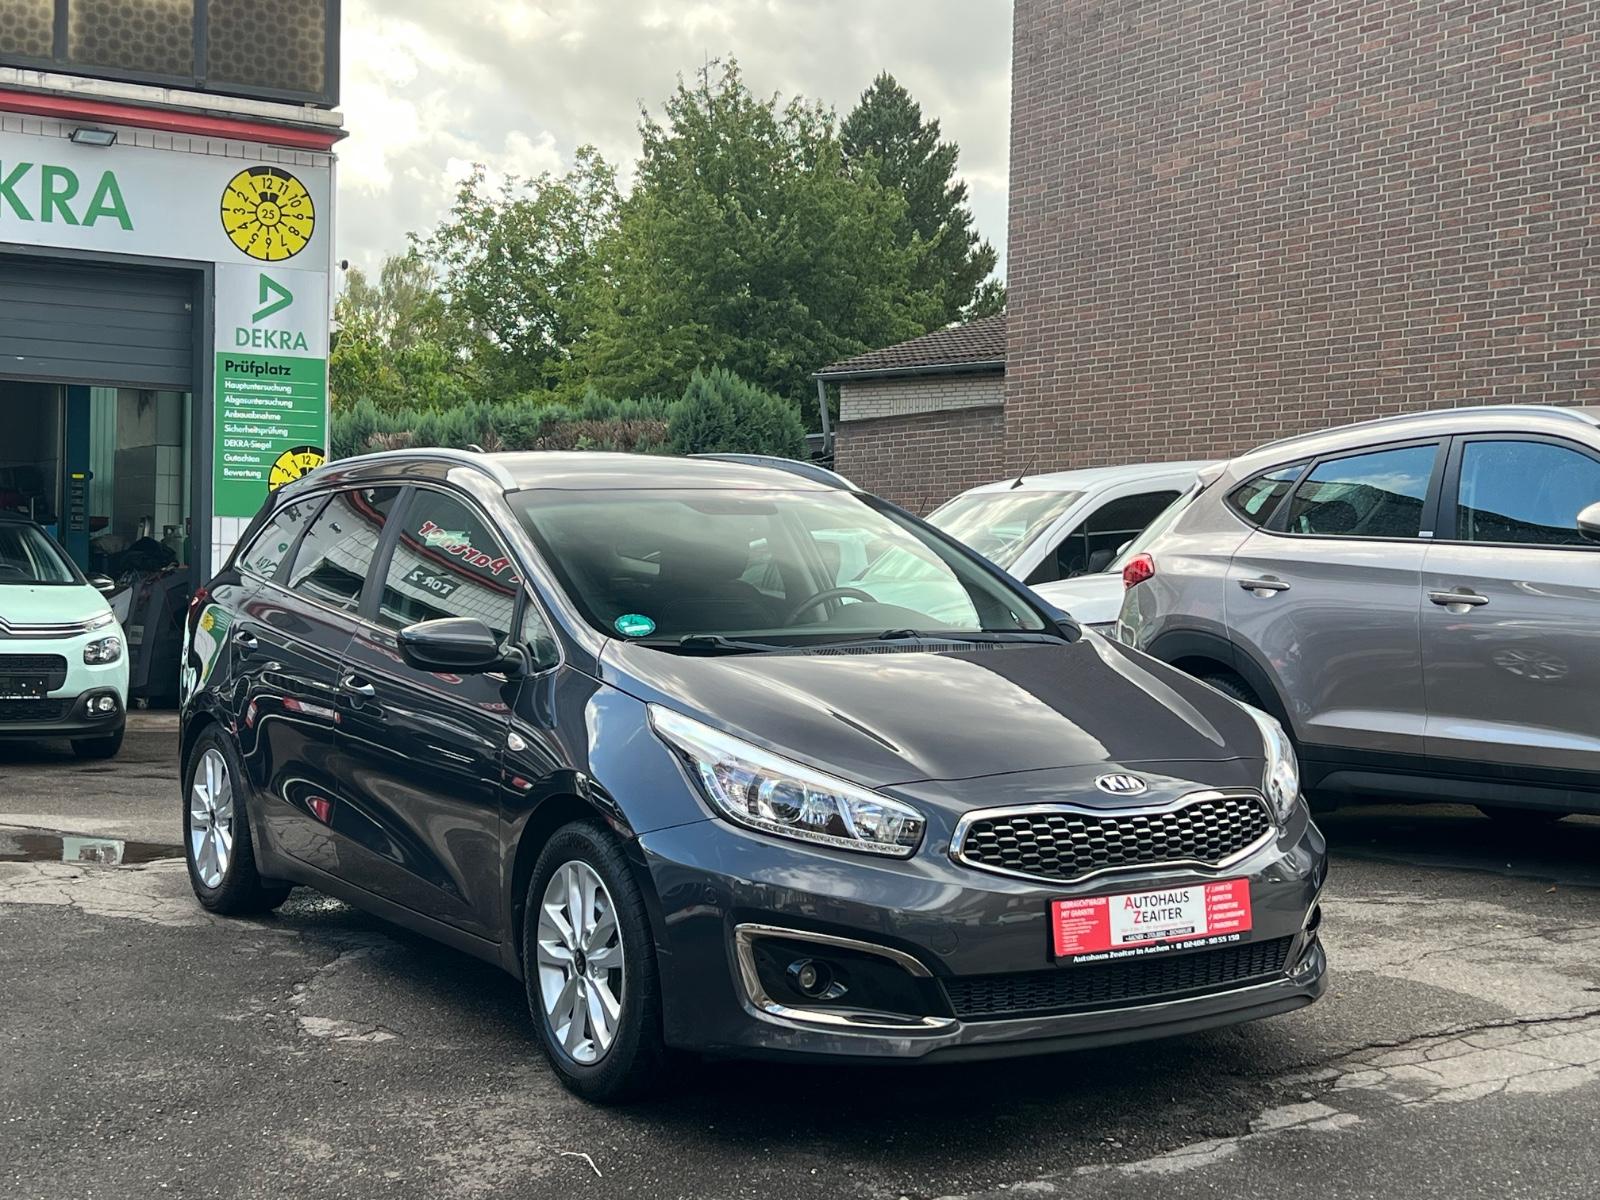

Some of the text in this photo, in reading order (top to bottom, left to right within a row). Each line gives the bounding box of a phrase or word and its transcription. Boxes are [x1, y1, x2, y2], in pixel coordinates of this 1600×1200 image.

[249, 182, 257, 193] 1
[262, 177, 273, 190] 12
[278, 182, 289, 195] 11
[237, 191, 249, 203] 2
[288, 194, 302, 208] 10
[233, 207, 246, 215] 3
[262, 208, 275, 219] 25
[236, 222, 248, 230] 4
[288, 226, 300, 236] 8
[249, 233, 259, 244] 5
[281, 234, 287, 247] 7
[235, 327, 309, 351] DEKRA
[225, 360, 292, 378] Prüfplatz
[224, 380, 292, 394] Hauptuntersuchung
[224, 395, 293, 409] Abgasuntersuchung
[224, 410, 282, 421] Anbauabnahme
[224, 424, 289, 437] Sicherheitsprüfung
[223, 439, 272, 450] DEKRA-Siegel
[223, 453, 260, 463] Gutachten
[291, 459, 298, 469] 1
[302, 455, 311, 465] 12
[223, 467, 262, 479] Bewertung
[282, 468, 292, 477] 2
[1103, 775, 1144, 791] KIA
[1124, 890, 1190, 910] AUTOHAUS
[1133, 907, 1183, 924] ZEAITER
[1073, 953, 1109, 963] Autohaus
[1109, 949, 1136, 959] Zeaiter
[1144, 945, 1170, 954] Aachen
